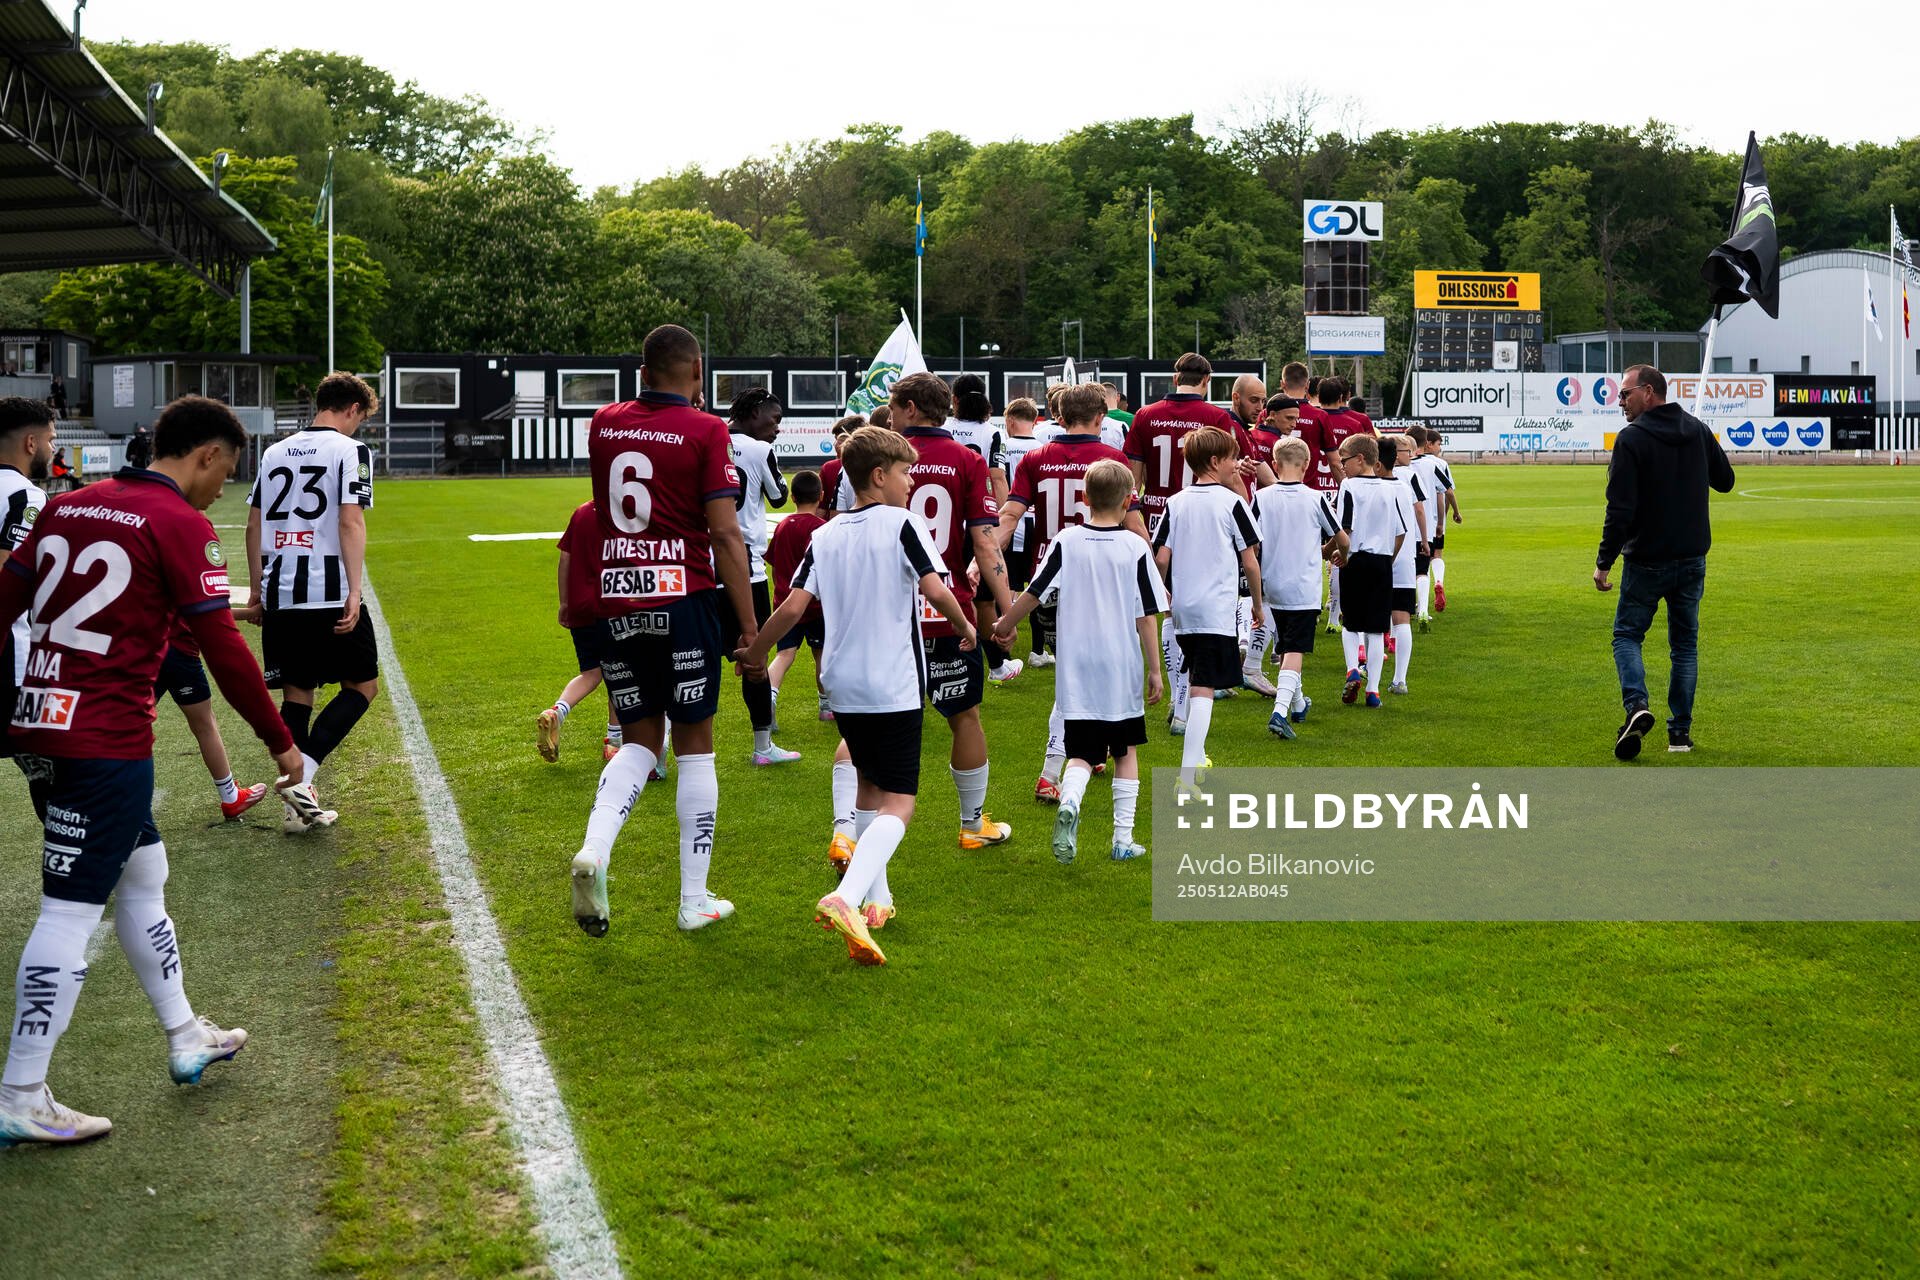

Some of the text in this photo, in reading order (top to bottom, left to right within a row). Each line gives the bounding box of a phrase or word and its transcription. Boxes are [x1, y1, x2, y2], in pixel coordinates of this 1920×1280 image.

[1308, 205, 1379, 236] GDL
[1438, 282, 1505, 299] OHLSSONS
[1311, 329, 1380, 338] BORGWARNER
[1779, 386, 1871, 403] HEMMAKVÄLL
[1373, 418, 1425, 428] ndbäckens
[774, 443, 804, 453] nova
[1499, 434, 1542, 450] KÖKS
[266, 466, 327, 520] 23
[609, 451, 654, 534] 6
[1038, 478, 1092, 540] 15
[602, 538, 685, 560] DYRESTAM
[32, 535, 132, 655] 22
[603, 570, 656, 595] BESAB
[146, 918, 179, 981] MIKE
[18, 966, 61, 1036] MIKE
